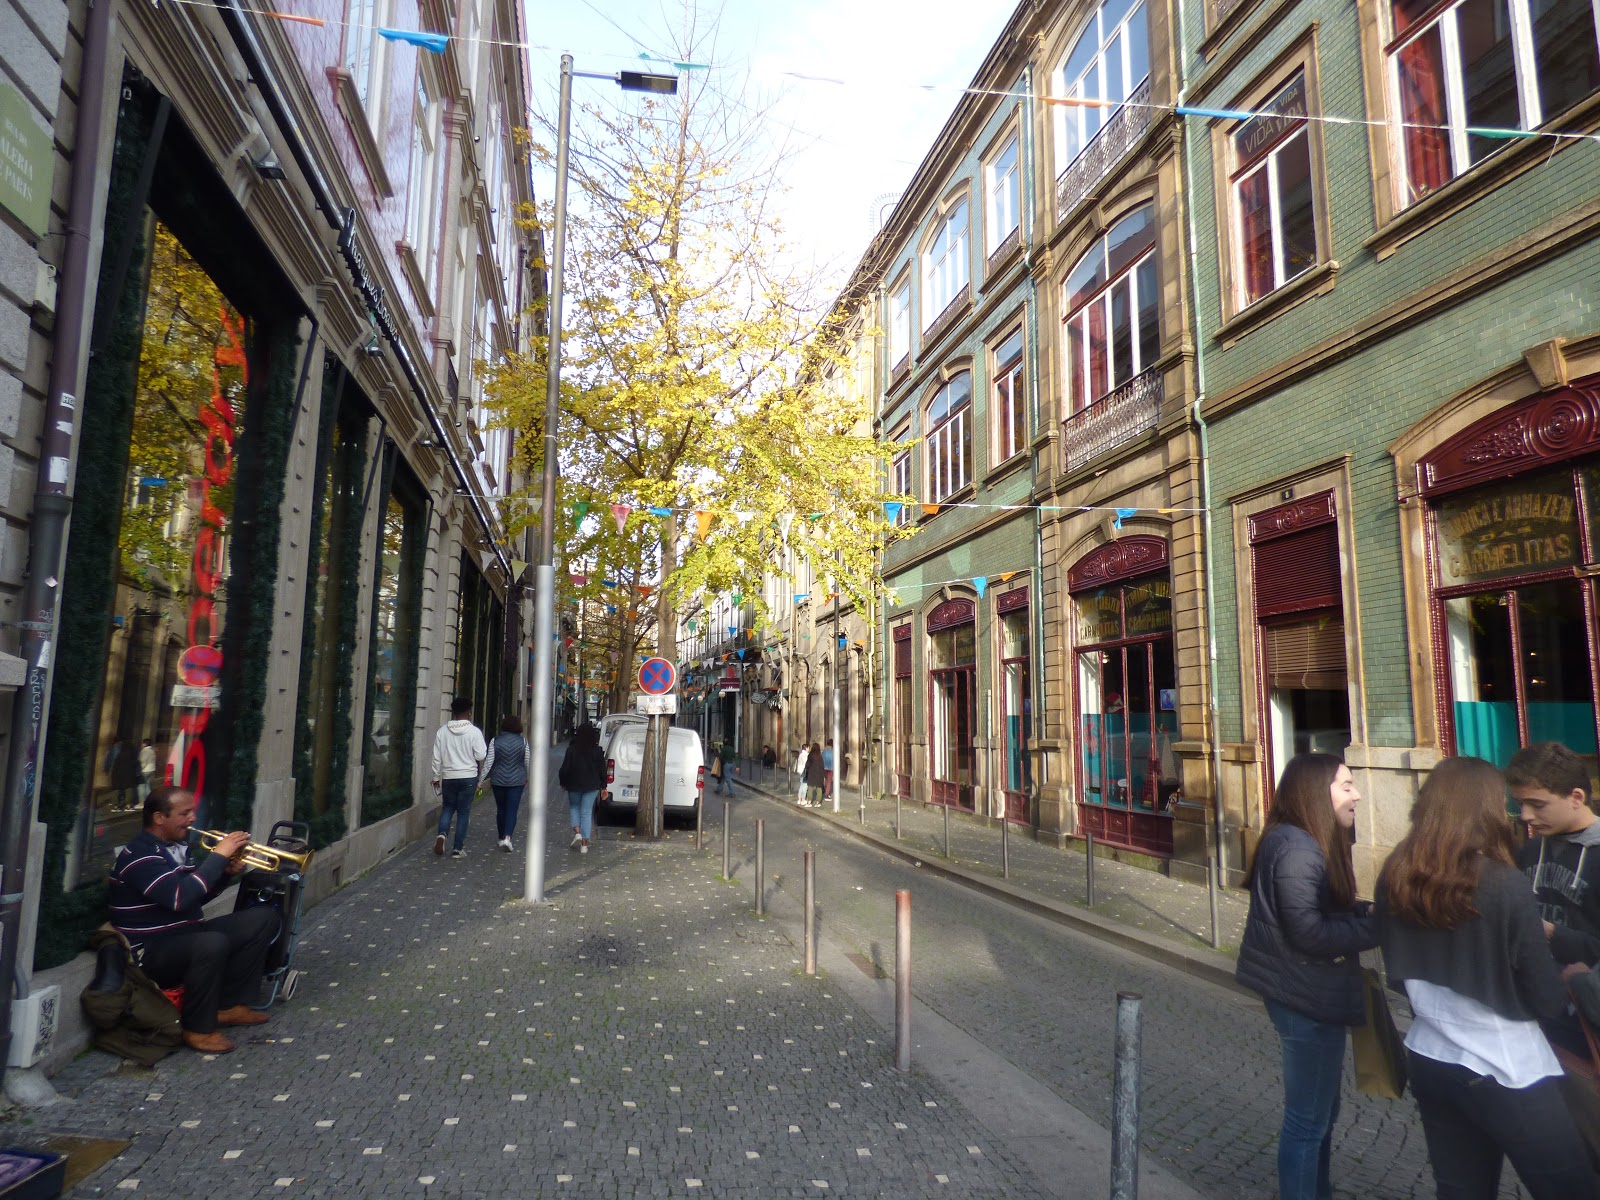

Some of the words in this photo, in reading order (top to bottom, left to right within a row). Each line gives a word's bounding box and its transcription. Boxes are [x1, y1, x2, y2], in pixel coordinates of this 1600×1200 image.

[1279, 88, 1298, 106] VIDA
[1245, 121, 1273, 153] VIDA
[1276, 102, 1303, 132] VIDA
[4, 164, 33, 203] PARIS
[347, 208, 379, 302] Marques
[1449, 533, 1571, 578] CARMELITAS
[1080, 619, 1120, 640] CARMELITAS
[1128, 610, 1171, 632] COMPANHI
